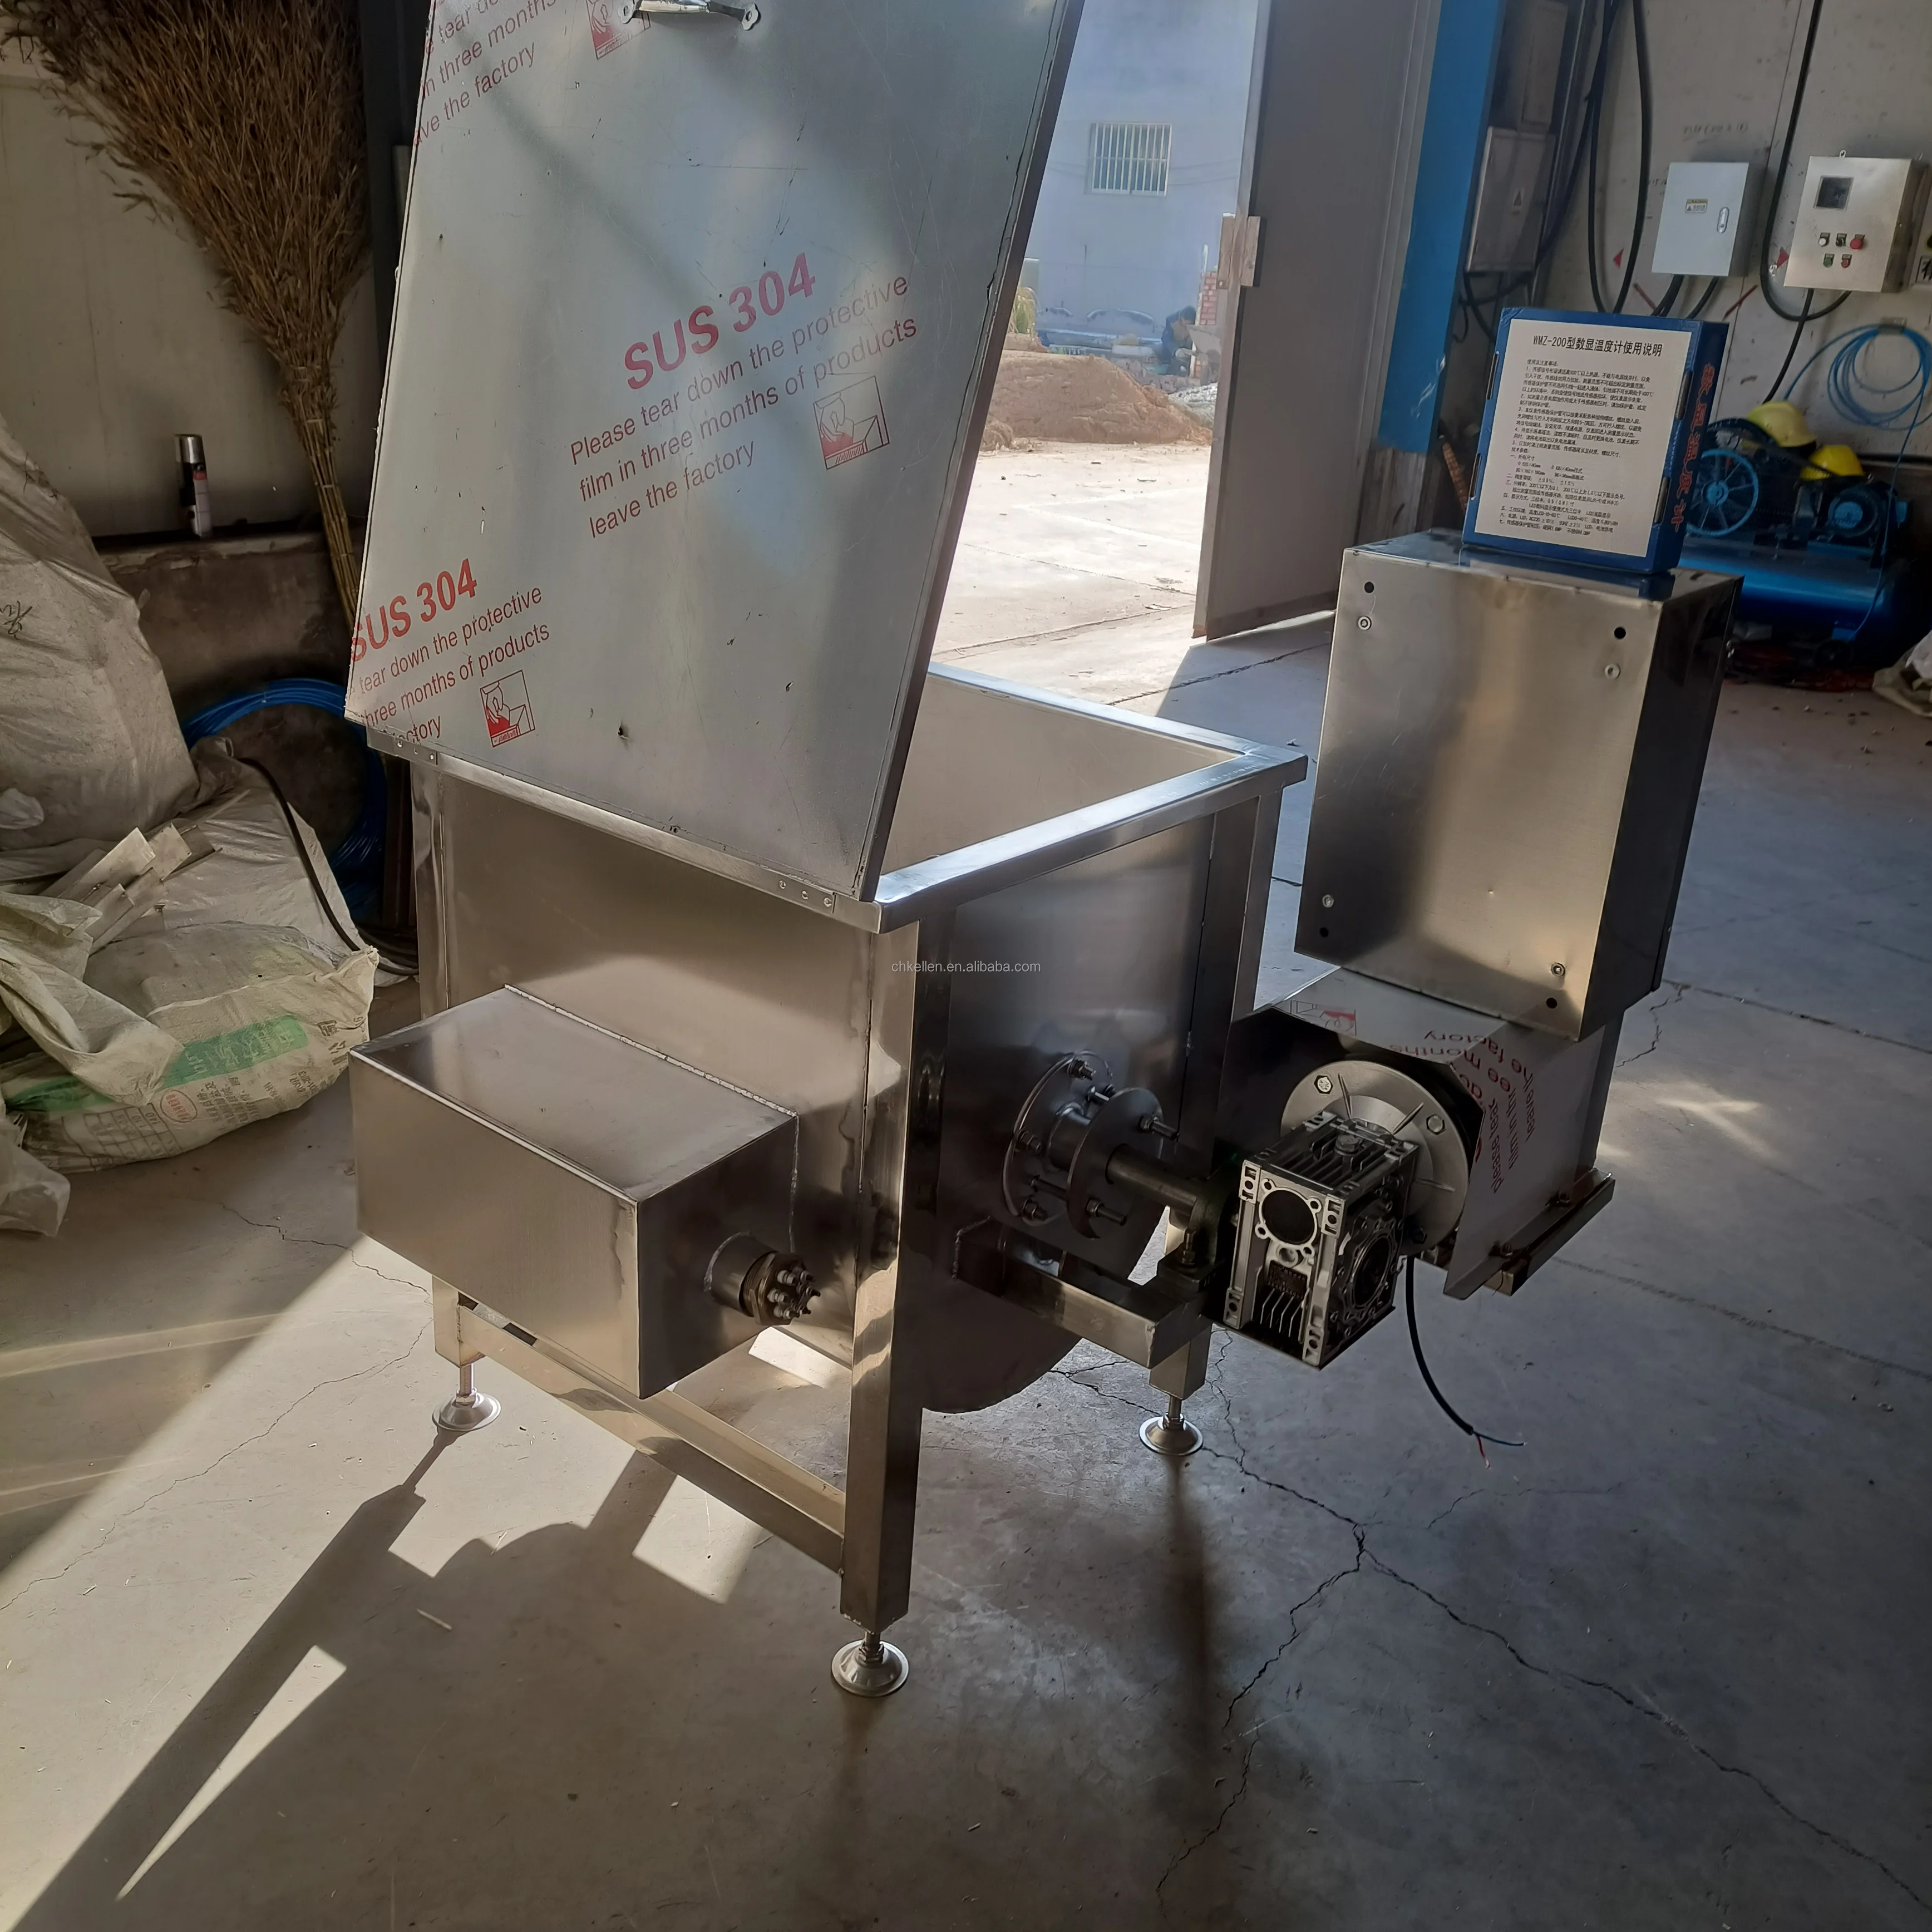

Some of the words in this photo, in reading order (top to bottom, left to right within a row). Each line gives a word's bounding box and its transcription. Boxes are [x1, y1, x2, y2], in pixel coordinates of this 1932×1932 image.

[438, 5, 471, 43] tear
[438, 42, 482, 85] three
[443, 91, 471, 120] the
[474, 42, 535, 98] factory
[624, 304, 720, 390] SUS
[729, 252, 816, 333] 304
[1533, 334, 1663, 357] WMZ-200型数显温度计使用说明
[570, 417, 636, 466] Please
[640, 390, 681, 427] tear
[687, 359, 744, 402] down
[749, 338, 785, 371] the
[792, 275, 909, 355] protective
[579, 468, 614, 502] film
[618, 458, 637, 482] in
[641, 428, 693, 471] three
[699, 385, 779, 441] months
[785, 367, 806, 396] of
[813, 316, 918, 388] products
[589, 499, 641, 538] leave
[646, 478, 678, 510] the
[682, 440, 755, 490] factory
[351, 595, 412, 662] SUS
[417, 558, 477, 622] 304
[359, 667, 386, 694] tear
[390, 645, 430, 678] down
[433, 630, 459, 655] the
[461, 587, 543, 646] protective
[400, 671, 456, 711] months
[459, 655, 475, 682] of
[479, 624, 550, 677] products
[1423, 1031, 1505, 1063] factory
[1487, 1067, 1517, 1118] three
[1511, 1058, 1534, 1093] the
[1488, 1097, 1500, 1141] tear
[1507, 1113, 1518, 1139] in
[1525, 1089, 1536, 1143] leave
[1508, 1131, 1520, 1170] film
